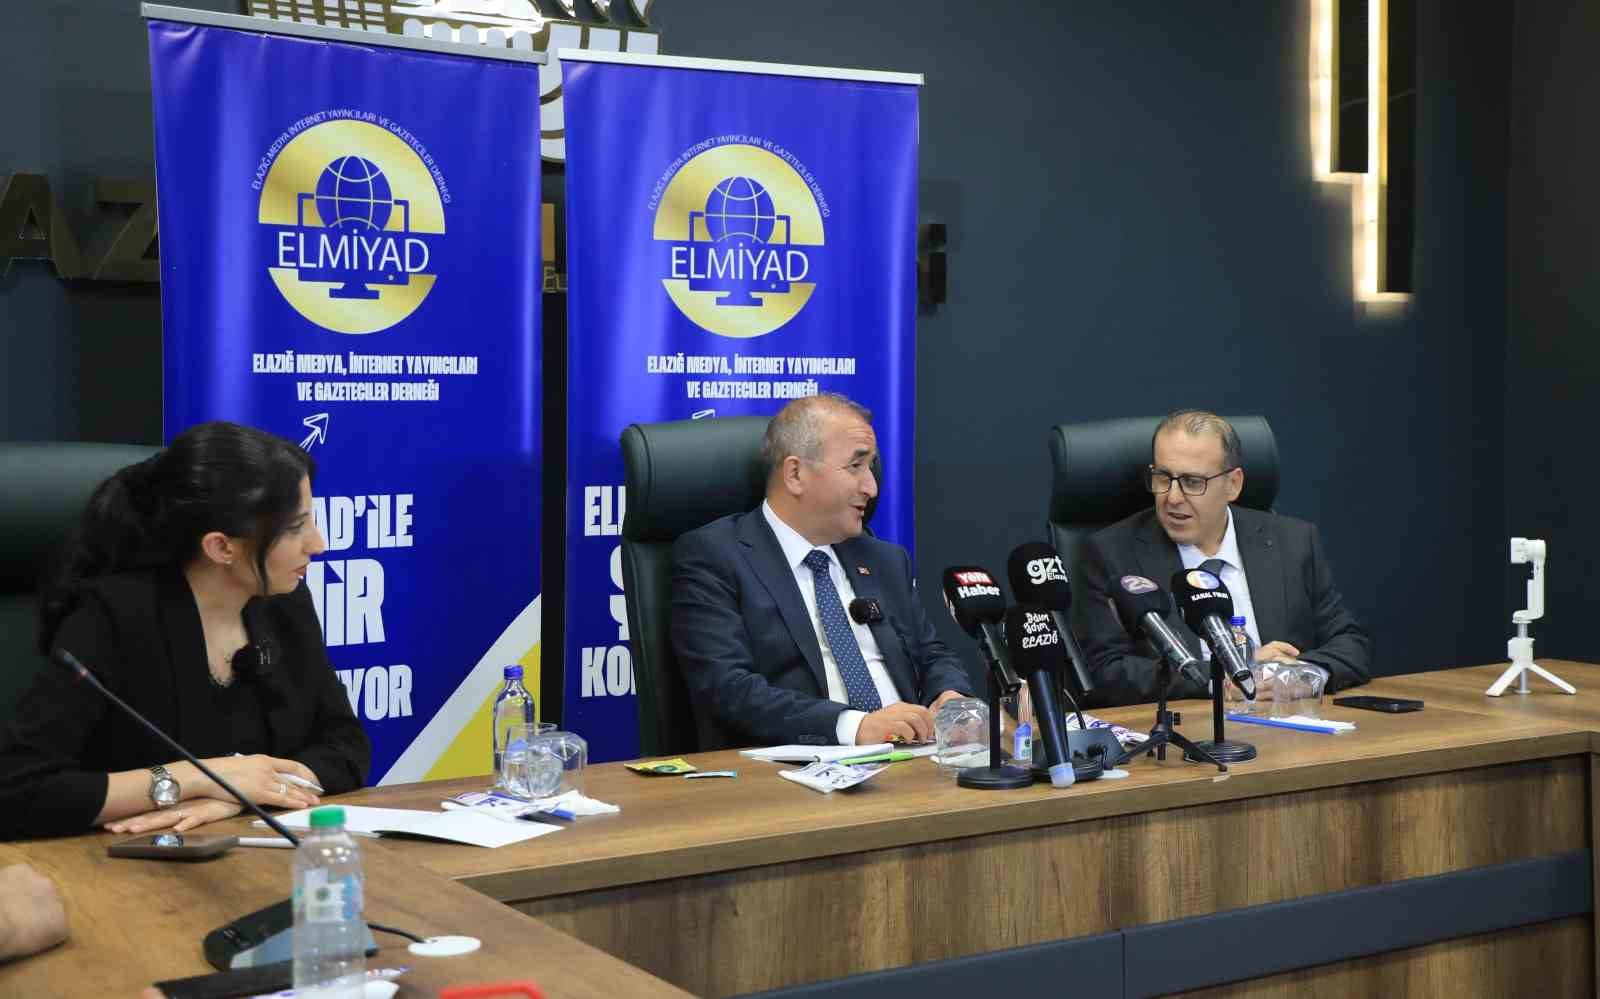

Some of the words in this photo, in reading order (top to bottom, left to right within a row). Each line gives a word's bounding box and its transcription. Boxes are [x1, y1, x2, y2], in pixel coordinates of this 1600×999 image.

[278, 228, 430, 273] ELMİYAD
[671, 242, 809, 282] ELMİYAD
[253, 350, 294, 373] ELAZIĞ
[296, 354, 347, 376] MEDYA,
[349, 351, 404, 375] İNTERNET
[406, 355, 478, 375] YAYINCILARI
[647, 353, 684, 374] ELAZIĞ
[686, 356, 732, 376] MEDYA,
[734, 353, 785, 375] İNTERNET
[787, 357, 856, 375] YAYINCILARI
[297, 382, 312, 401] VE
[686, 381, 701, 399] VE
[957, 584, 1001, 599] Haber
[581, 645, 637, 698] KO
[335, 664, 414, 721] YOR
